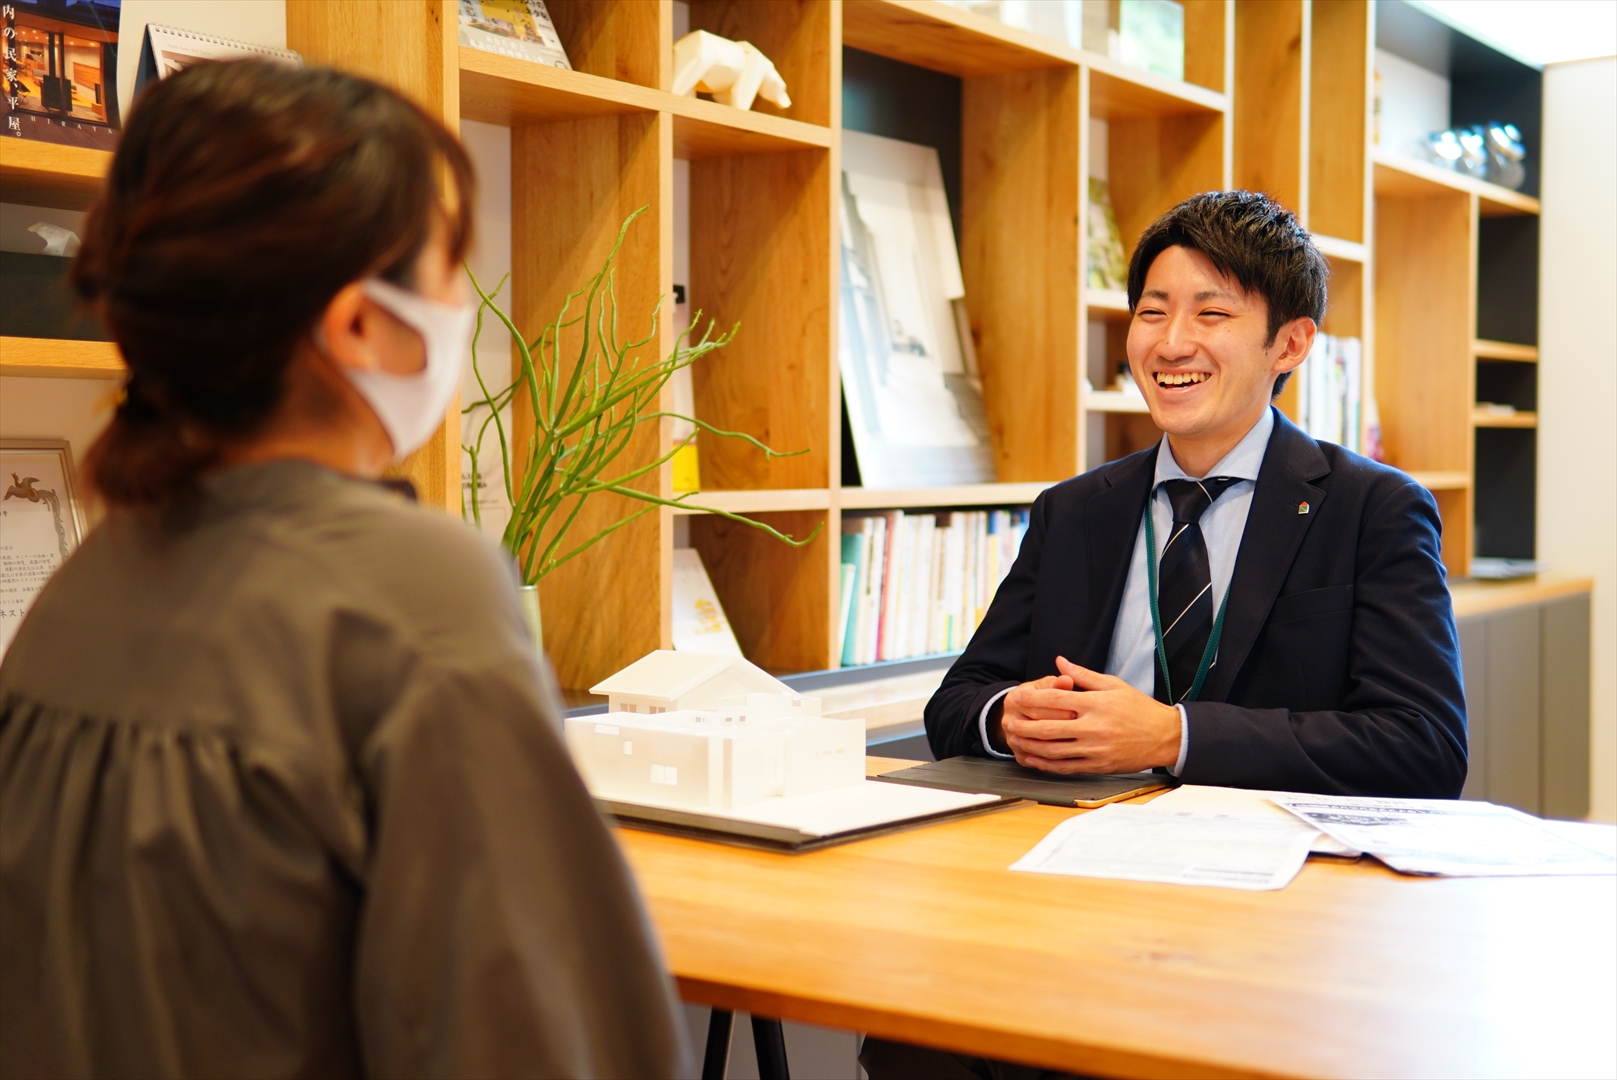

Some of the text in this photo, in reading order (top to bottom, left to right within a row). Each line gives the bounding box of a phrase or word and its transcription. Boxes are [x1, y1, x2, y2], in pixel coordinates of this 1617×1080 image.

[2, 4, 22, 137] 内の民家、平屋。
